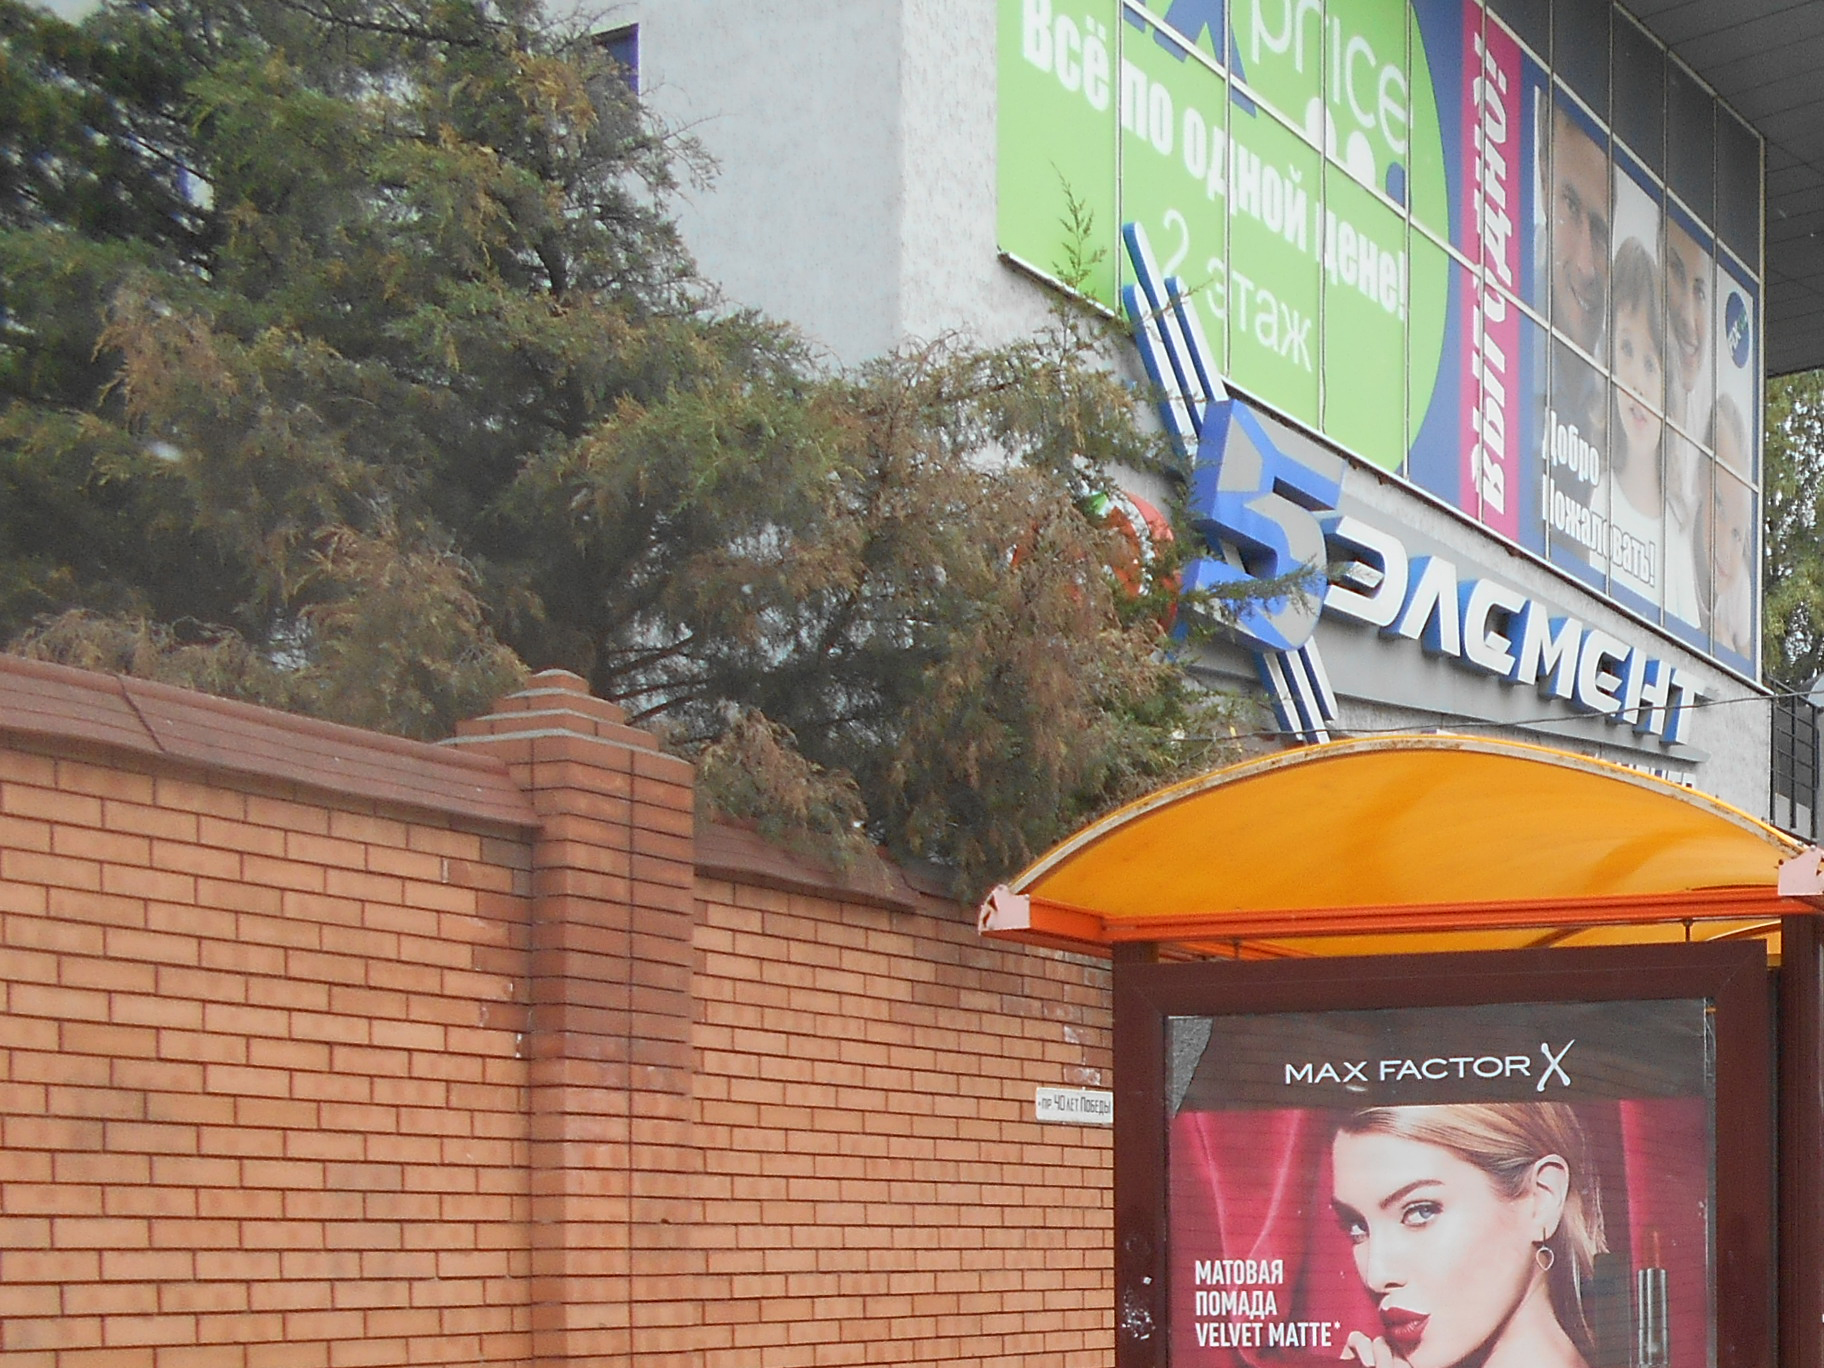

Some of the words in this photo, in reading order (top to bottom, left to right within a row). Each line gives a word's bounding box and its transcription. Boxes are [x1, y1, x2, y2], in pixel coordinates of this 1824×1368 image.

[1120, 57, 1174, 157] по
[1183, 106, 1308, 253] одной
[1315, 203, 1408, 321] цене!
[1206, 256, 1312, 372] этаж
[1542, 406, 1600, 486] Добро
[1284, 1060, 1370, 1086] MAX
[1378, 1055, 1532, 1082] FACTOR
[1195, 1260, 1284, 1286] МАТОВАЯ
[1195, 1290, 1278, 1319] ПОМАДА
[1195, 1322, 1263, 1348] VELVET
